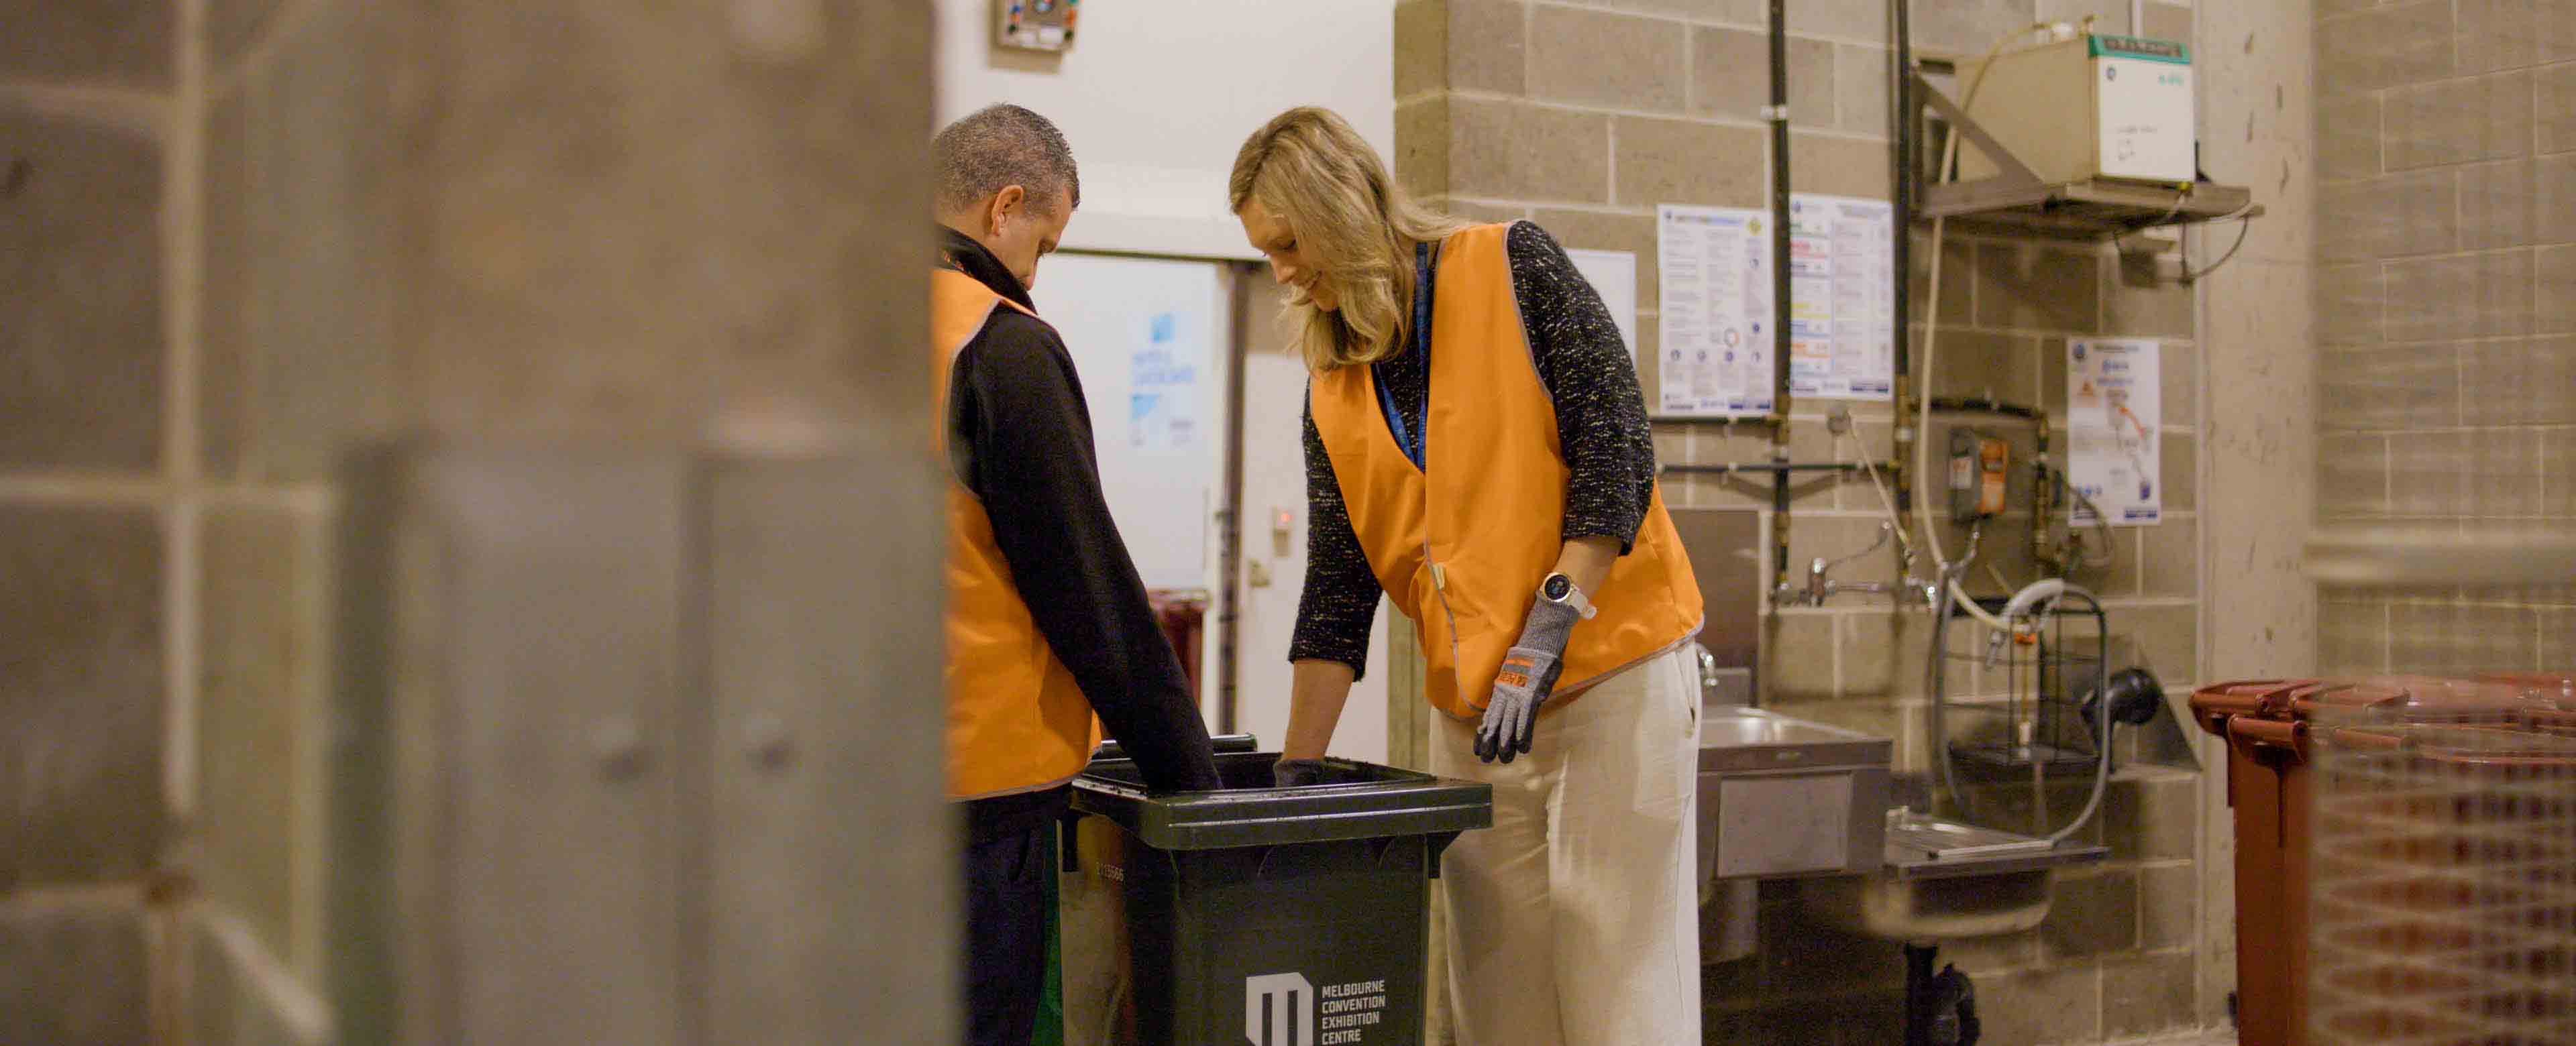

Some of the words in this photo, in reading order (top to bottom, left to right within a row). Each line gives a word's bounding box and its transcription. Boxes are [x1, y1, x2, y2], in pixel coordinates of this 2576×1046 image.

[1321, 980, 1386, 998] MELBOURNE
[1321, 995, 1386, 1014] CONVENTION
[1321, 1011, 1381, 1029] EXHIBITION
[1321, 1029, 1362, 1045] CENTRE
